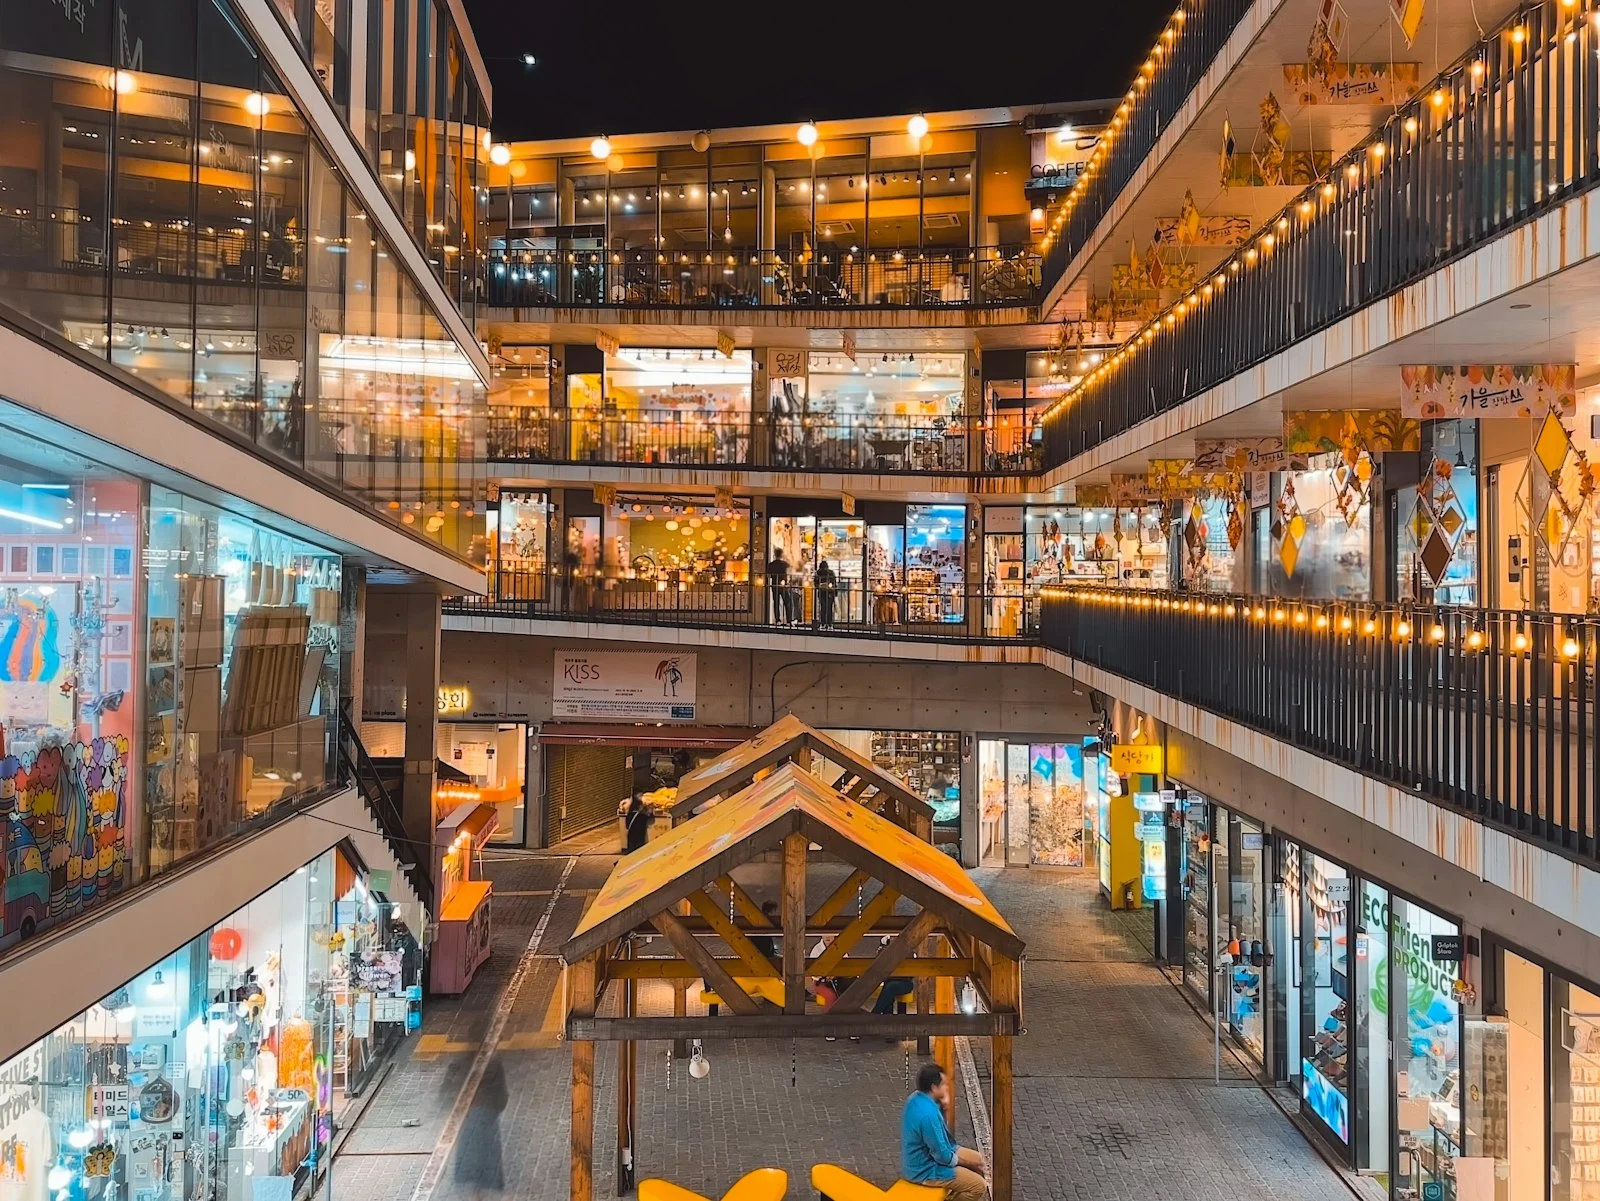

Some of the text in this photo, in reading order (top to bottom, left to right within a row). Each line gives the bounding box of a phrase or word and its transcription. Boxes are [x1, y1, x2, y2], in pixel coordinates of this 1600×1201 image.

[1030, 161, 1090, 178] COFFE
[563, 664, 600, 684] KISS
[0, 1055, 30, 1097] TIVE
